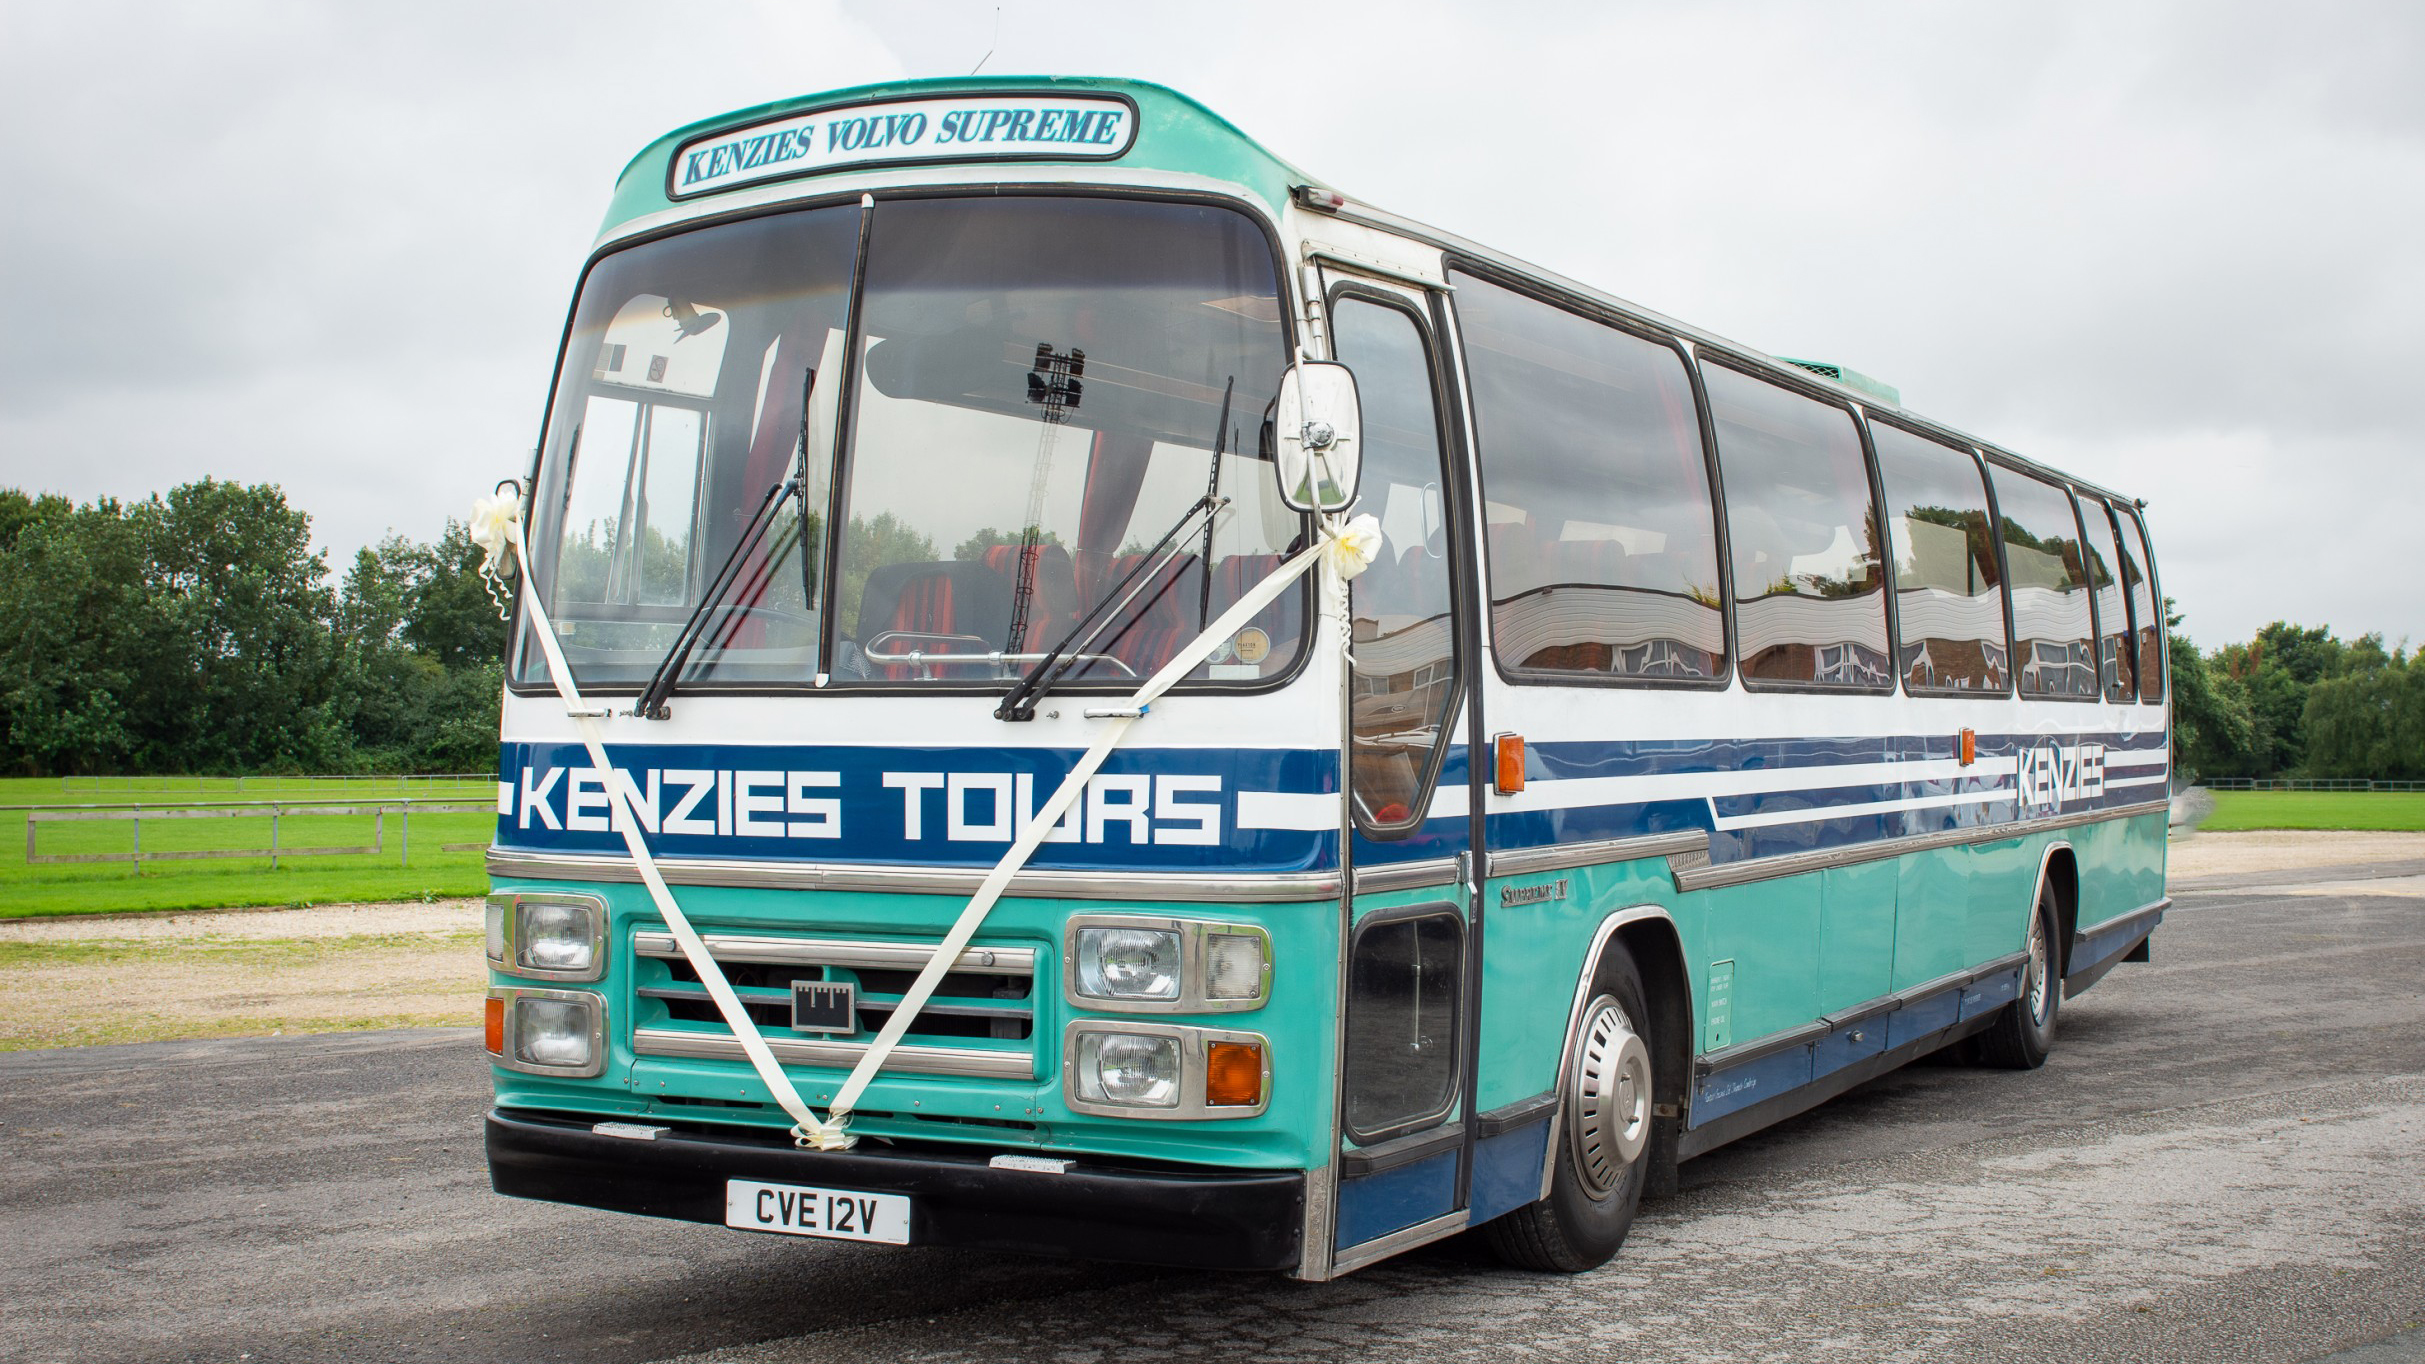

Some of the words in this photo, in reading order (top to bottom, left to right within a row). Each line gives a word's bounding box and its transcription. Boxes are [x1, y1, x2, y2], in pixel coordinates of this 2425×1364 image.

[682, 125, 815, 187] KENZIES
[826, 112, 928, 152] VOLVO
[934, 108, 1123, 146] SUPREME
[519, 766, 841, 838] KENZIES
[882, 771, 1221, 845] TOURS
[2018, 745, 2104, 806] KENZIES
[756, 1189, 817, 1228] CVE
[827, 1196, 877, 1234] 12V
